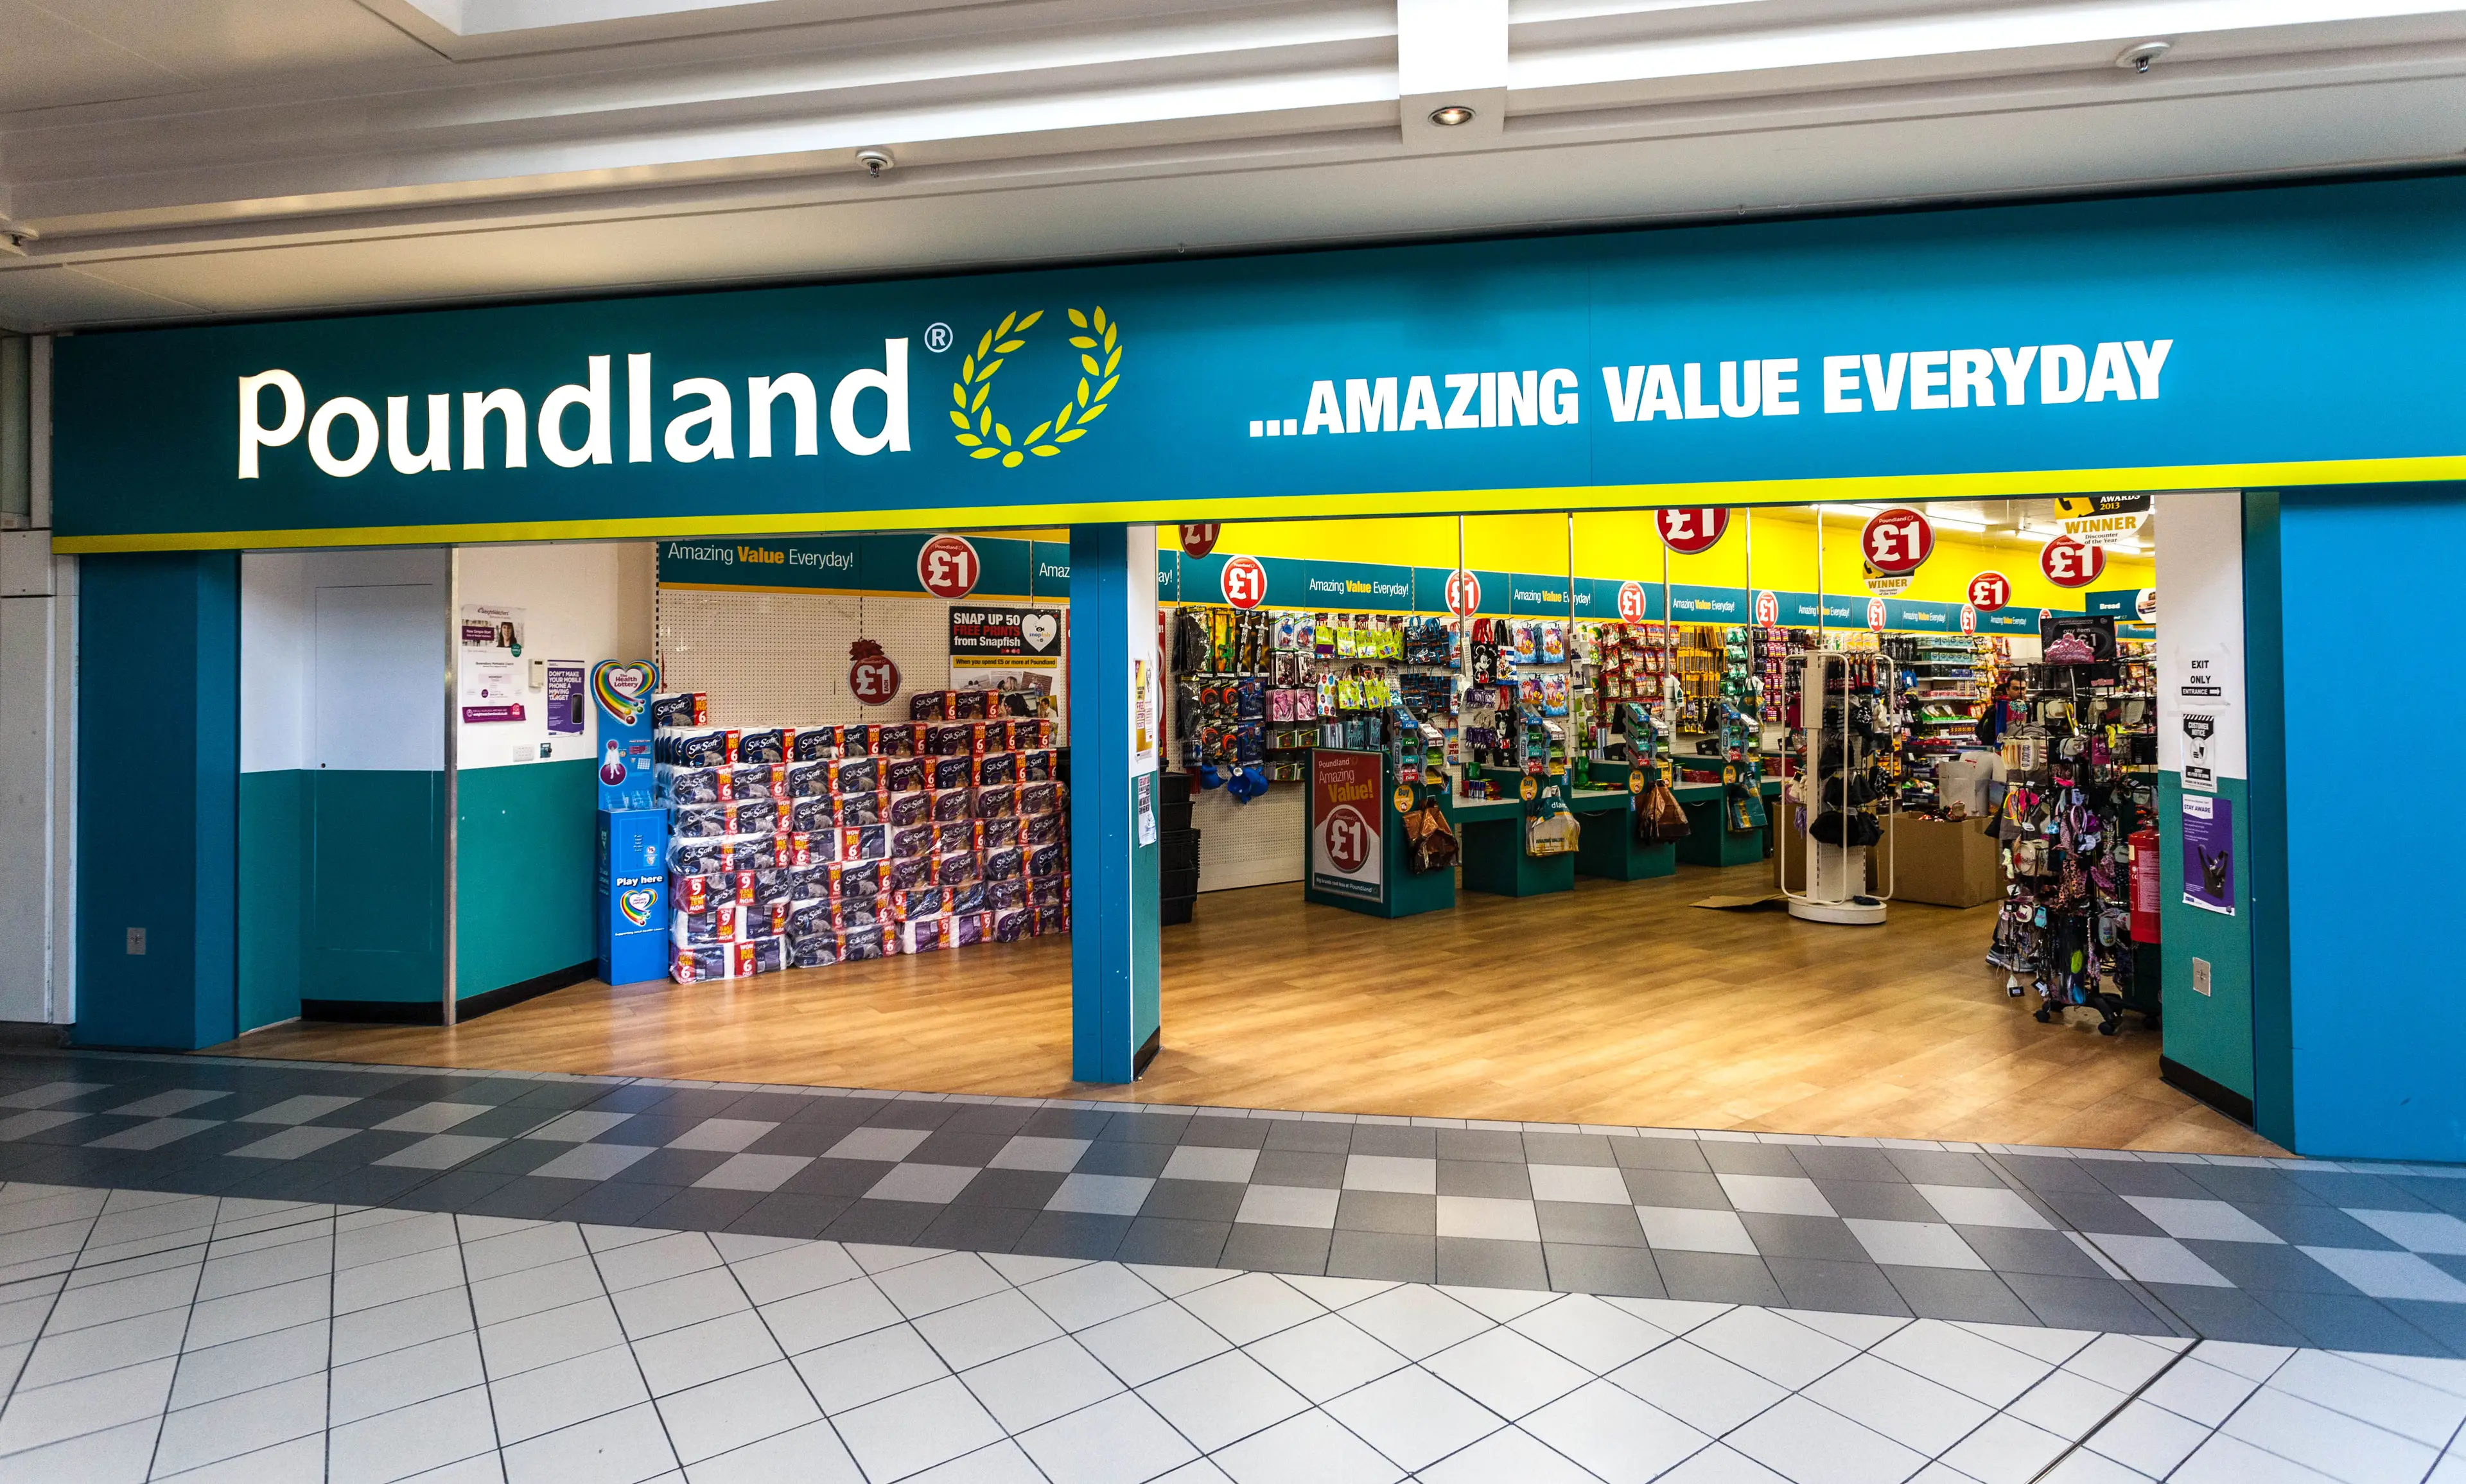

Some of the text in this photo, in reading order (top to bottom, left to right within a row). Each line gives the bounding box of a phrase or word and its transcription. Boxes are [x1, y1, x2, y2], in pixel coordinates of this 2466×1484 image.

[1602, 358, 1799, 423] VALUE
[1823, 339, 2173, 414] EVERYDAY
[238, 337, 911, 479] Poundland
[2065, 516, 2136, 534] WINNER
[1871, 521, 1920, 563] £1
[668, 542, 853, 570] Amazing Value Everyday!
[2049, 545, 2094, 578] £1
[928, 550, 968, 587] £1
[1039, 563, 1070, 578] Amaz
[1229, 568, 1258, 600] £1
[1309, 578, 1408, 598] Amazing Value Everyday!
[1868, 579, 1907, 589] WINNER
[1451, 581, 1474, 609] £1
[1514, 589, 1591, 606] Amazing Value Evryday!
[1973, 580, 2003, 606] £1
[1623, 591, 1640, 616] £1
[1673, 598, 1735, 613] Amazing Value Everyday!
[1758, 600, 1774, 622] £1
[1798, 605, 1850, 618] Amazing Everyday!
[1870, 606, 1883, 626] £1
[1903, 611, 1918, 622] Amazing
[1930, 613, 1946, 623] Everyday!
[954, 613, 1020, 626] SNAP UP 50
[1963, 611, 1974, 631] £1
[954, 625, 1020, 636] FREE PRINTS
[954, 636, 1020, 649] from Snapfish
[2191, 660, 2209, 668] EXIT
[856, 664, 890, 695] £1
[2190, 676, 2211, 684] ONLY
[926, 697, 941, 706] Soft
[968, 695, 983, 704] Soft
[670, 700, 688, 713] Soft
[949, 706, 956, 716] 6
[990, 704, 997, 715] 6
[698, 711, 706, 723] 6
[814, 733, 830, 745] Soft
[846, 732, 863, 742] Soft
[895, 730, 911, 740] Soft
[953, 729, 970, 740] Soft
[702, 738, 721, 751] Soft
[871, 742, 879, 754] 6
[976, 738, 983, 749] 6
[730, 749, 739, 761] 6
[787, 747, 794, 759] 6
[905, 764, 920, 774] Soft
[997, 758, 1011, 770] Soft
[1318, 757, 1350, 769] Poundland
[857, 765, 874, 776] Soft
[1318, 768, 1355, 784] Amazing
[1523, 779, 1533, 787] Buy
[1327, 779, 1374, 803] Value!
[1398, 788, 1410, 797] Buy
[1331, 819, 1361, 862] £1
[848, 844, 857, 857] 6
[616, 875, 663, 886] Play here
[1350, 883, 1372, 893] Poundland
[743, 959, 753, 972] 6
